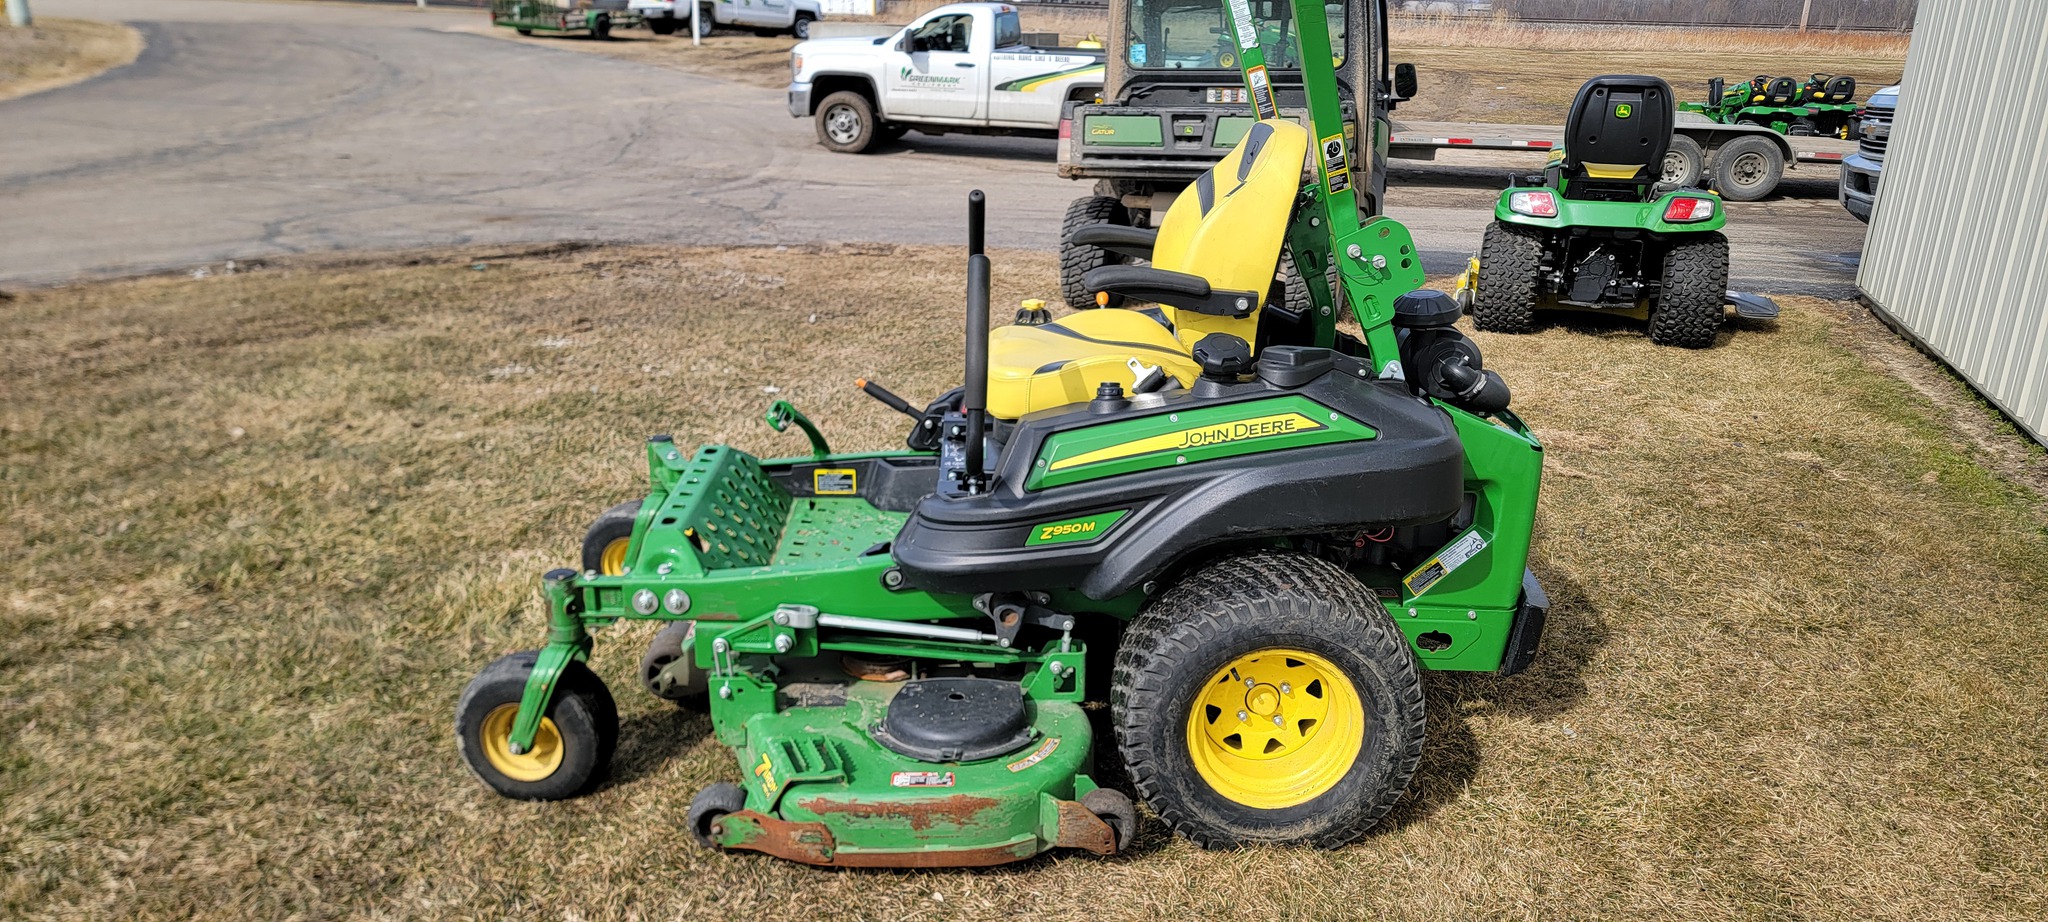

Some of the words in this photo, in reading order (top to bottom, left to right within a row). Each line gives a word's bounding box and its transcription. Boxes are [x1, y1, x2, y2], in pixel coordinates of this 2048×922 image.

[1179, 428, 1229, 446] JOHN
[1234, 419, 1295, 438] DEERE
[1040, 521, 1096, 540] Z950M
